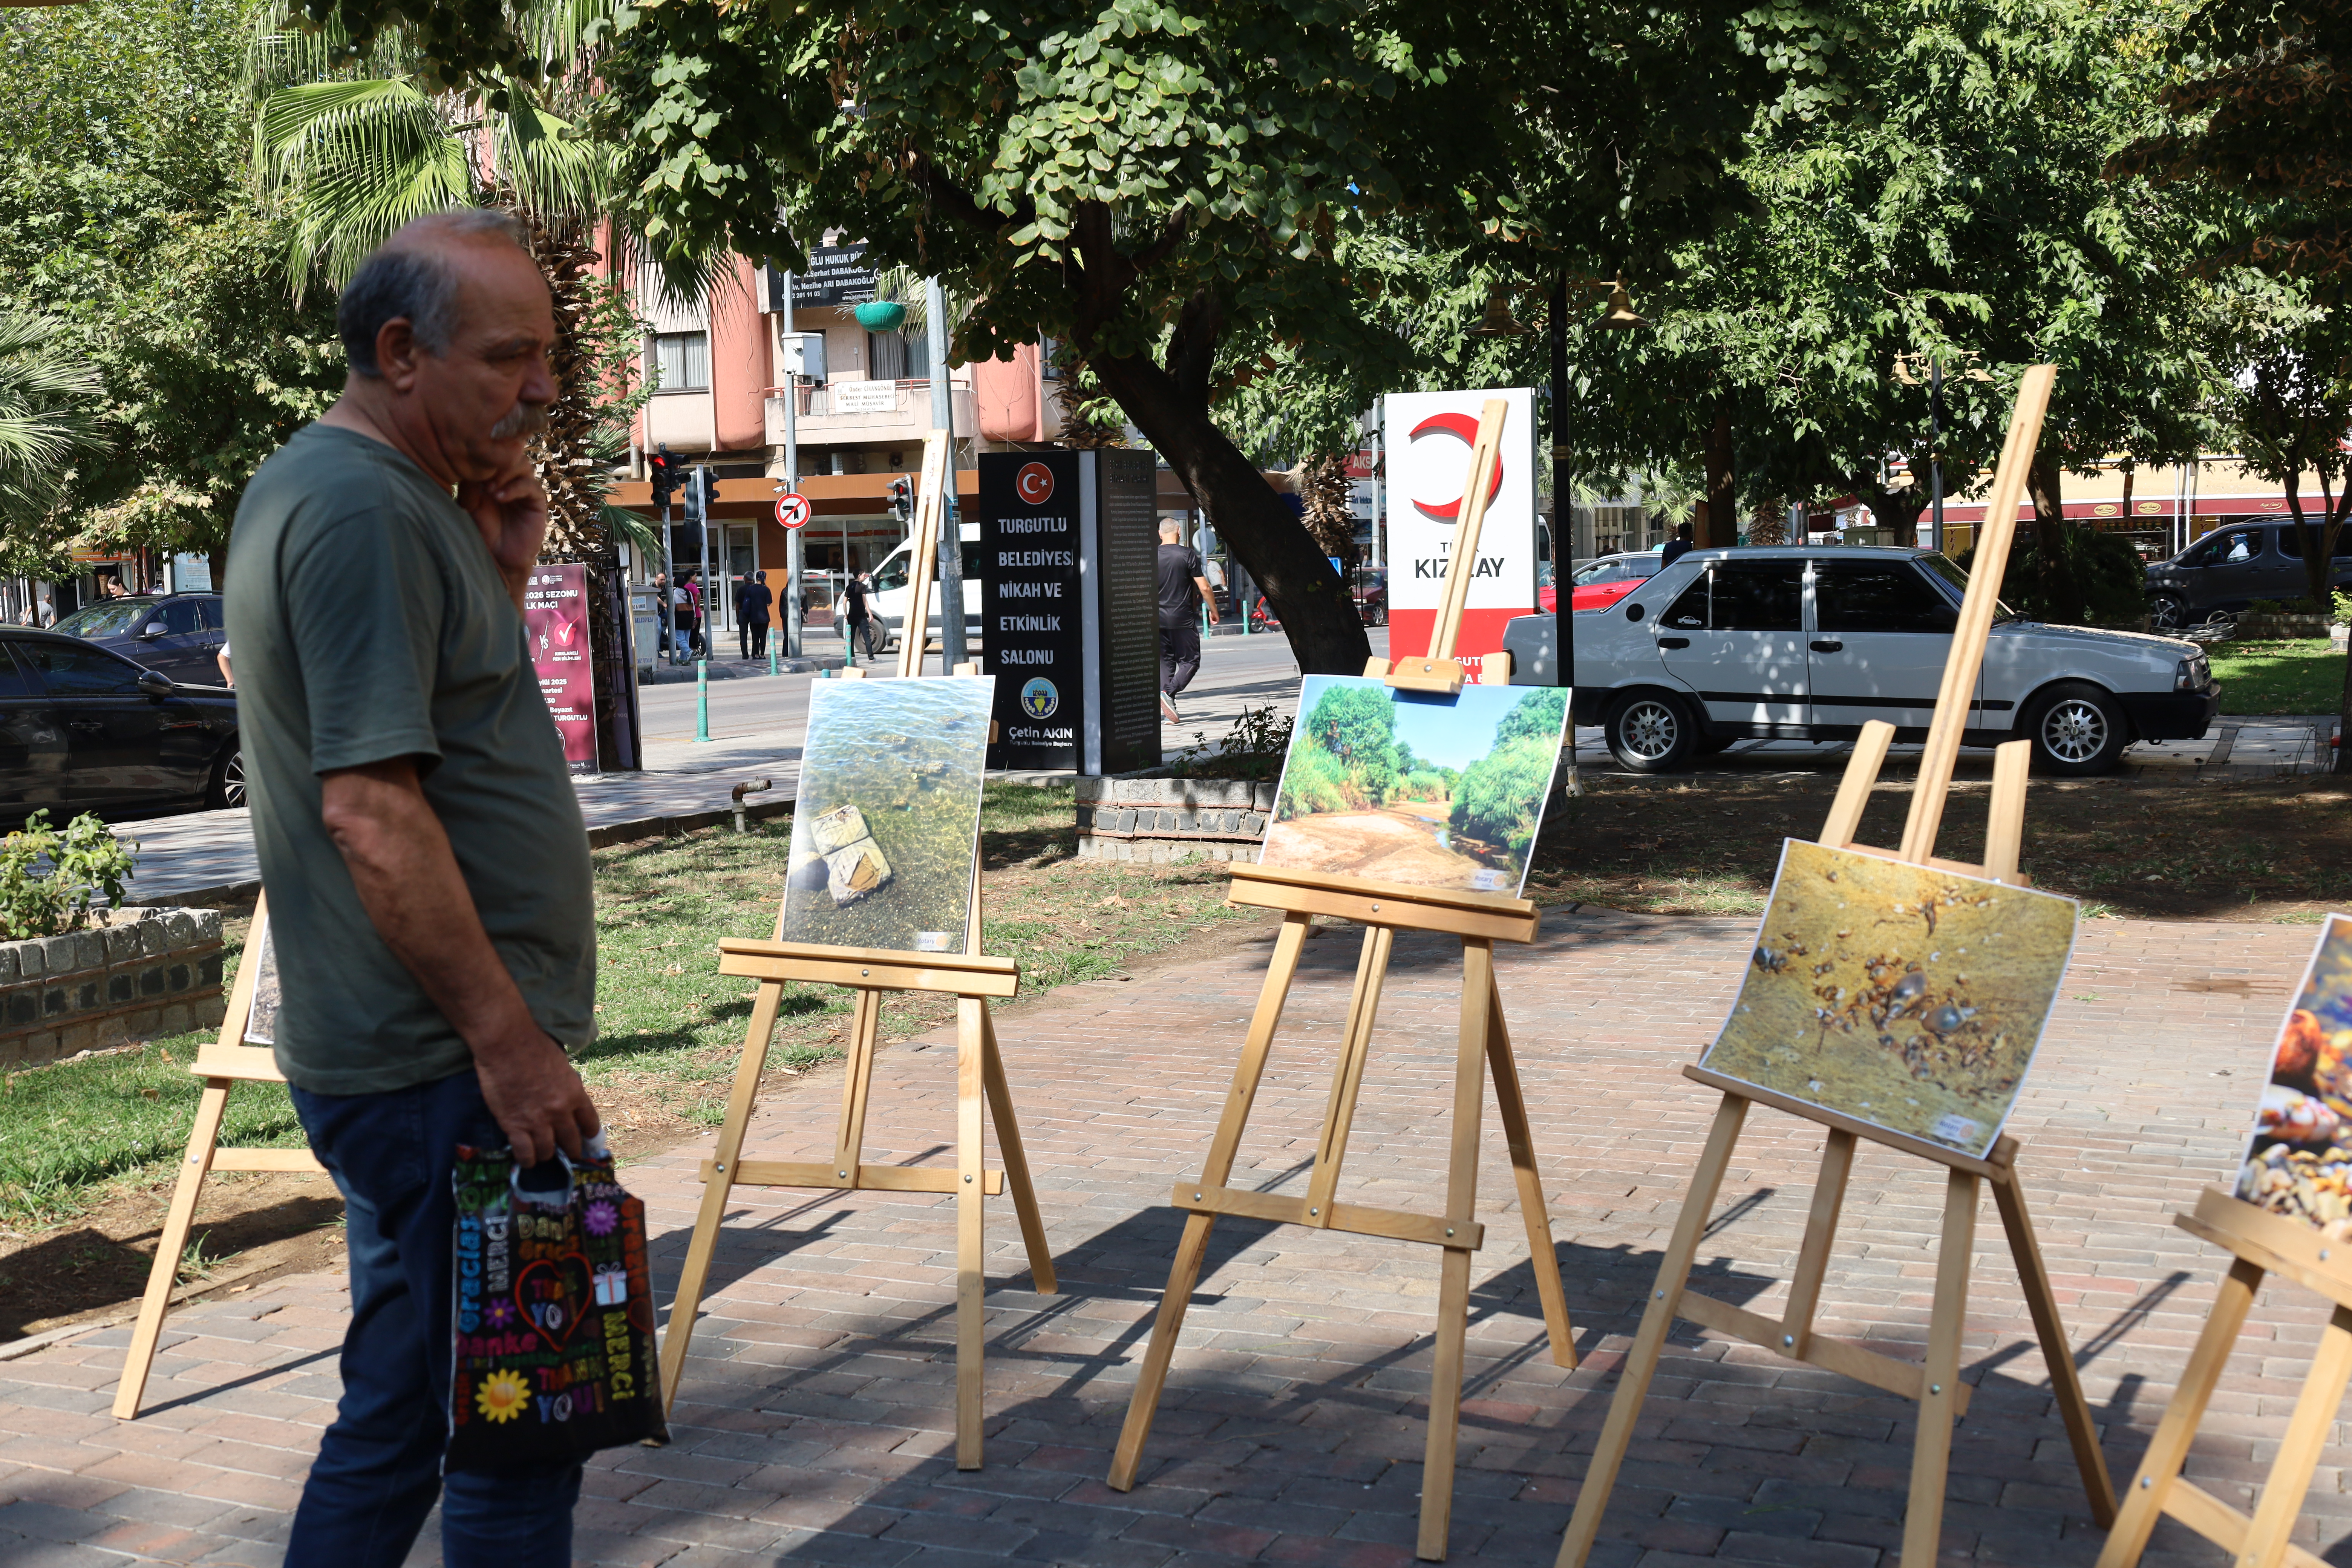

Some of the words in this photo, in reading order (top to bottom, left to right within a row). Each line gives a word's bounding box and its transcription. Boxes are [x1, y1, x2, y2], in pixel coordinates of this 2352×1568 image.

[825, 253, 849, 265] HUKUK
[801, 281, 822, 290] Nezihe
[823, 280, 834, 288] ARI
[836, 276, 874, 287] DABAKOĞLU
[998, 517, 1067, 534] TURGUTLU
[999, 548, 1073, 567] BELEDİYESİ
[545, 590, 578, 599] SEZONU
[999, 581, 1041, 599] NİKAH
[1044, 582, 1062, 598] VE
[537, 601, 558, 609] MAÇI
[1000, 613, 1061, 631] ETKİNLİK
[539, 634, 548, 649] VS
[1001, 649, 1054, 665] SALONU
[1009, 726, 1040, 740] Çetin
[1043, 728, 1073, 739] AKIN
[457, 1215, 481, 1334] Gracias
[456, 1330, 539, 1357] Danke
[536, 1355, 605, 1391] THANK
[536, 1380, 605, 1424] YOU!
